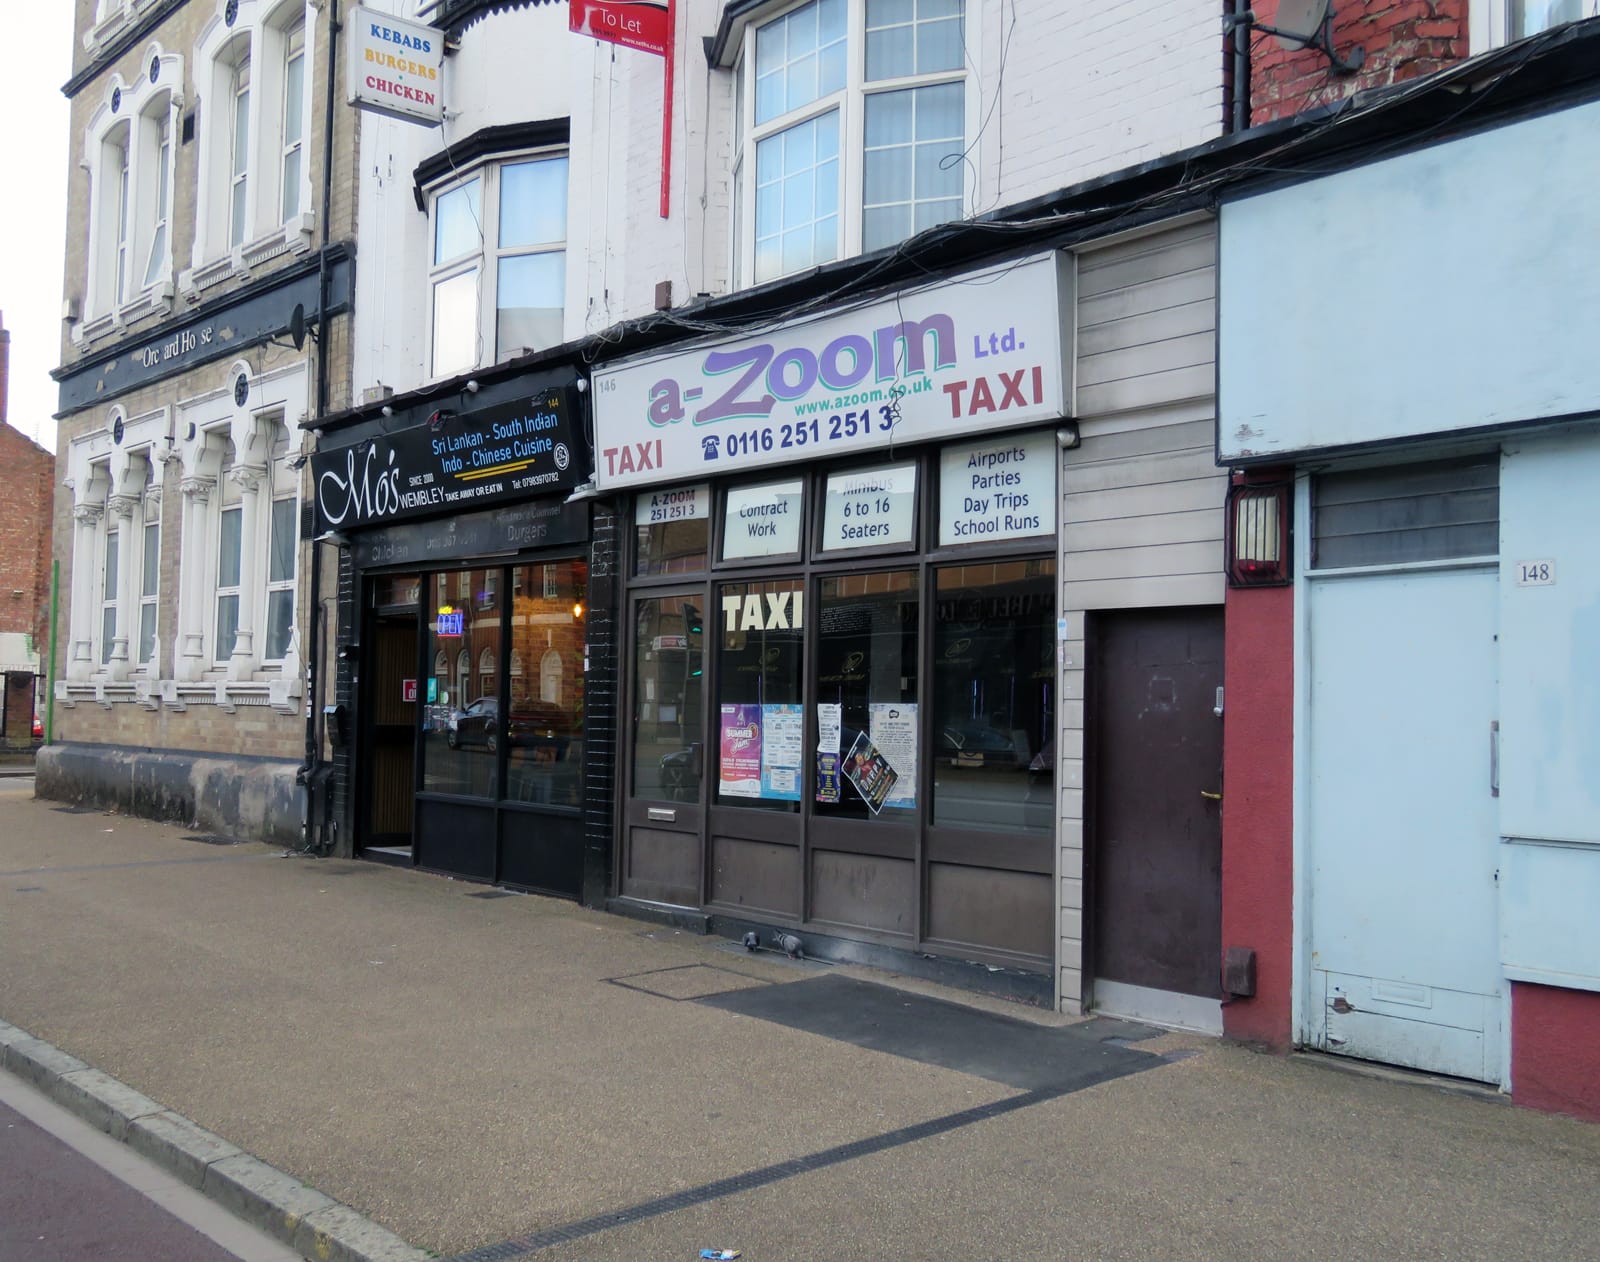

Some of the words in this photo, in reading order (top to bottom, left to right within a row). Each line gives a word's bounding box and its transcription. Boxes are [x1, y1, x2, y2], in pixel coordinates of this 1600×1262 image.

[600, 8, 616, 26] To
[620, 14, 641, 34] Let
[370, 23, 431, 54] KEBABS
[364, 48, 437, 81] BURGERS
[365, 76, 435, 105] CHICKEN
[973, 327, 1025, 359] Ltd.
[599, 379, 616, 393] 146
[794, 375, 933, 416] www.azoom.co.uk
[943, 366, 1044, 419] TAXI
[548, 398, 559, 408] 144
[432, 439, 447, 455] Sri
[449, 432, 484, 451] Lankan
[492, 418, 523, 440] South
[525, 412, 558, 434] Indian
[727, 428, 773, 457] 0116
[780, 419, 819, 448] 251
[442, 457, 463, 474] Indo
[472, 448, 512, 468] Chinese
[514, 437, 552, 458] Cuisine
[603, 439, 663, 477] TAXI
[967, 447, 1026, 469] Airports
[409, 473, 423, 487] SINCE
[972, 471, 1021, 490] Parties
[399, 486, 445, 510] WEMBLEY
[445, 491, 460, 502] TAKE
[460, 488, 476, 499] AWAY
[476, 486, 485, 496] OR
[651, 489, 696, 507] A-ZOOM
[964, 497, 989, 515] Day
[994, 492, 1029, 511] Trips
[651, 508, 667, 521] 251
[740, 500, 788, 518] Contract
[844, 503, 851, 518] 6
[856, 502, 870, 516] to
[875, 499, 890, 514] 16
[748, 521, 776, 537] Work
[841, 522, 889, 540] Seaters
[953, 516, 999, 536] School
[1004, 515, 1040, 531] Runs
[1522, 563, 1549, 582] 148
[722, 591, 804, 632] TAXI
[437, 614, 463, 634] OPEN
